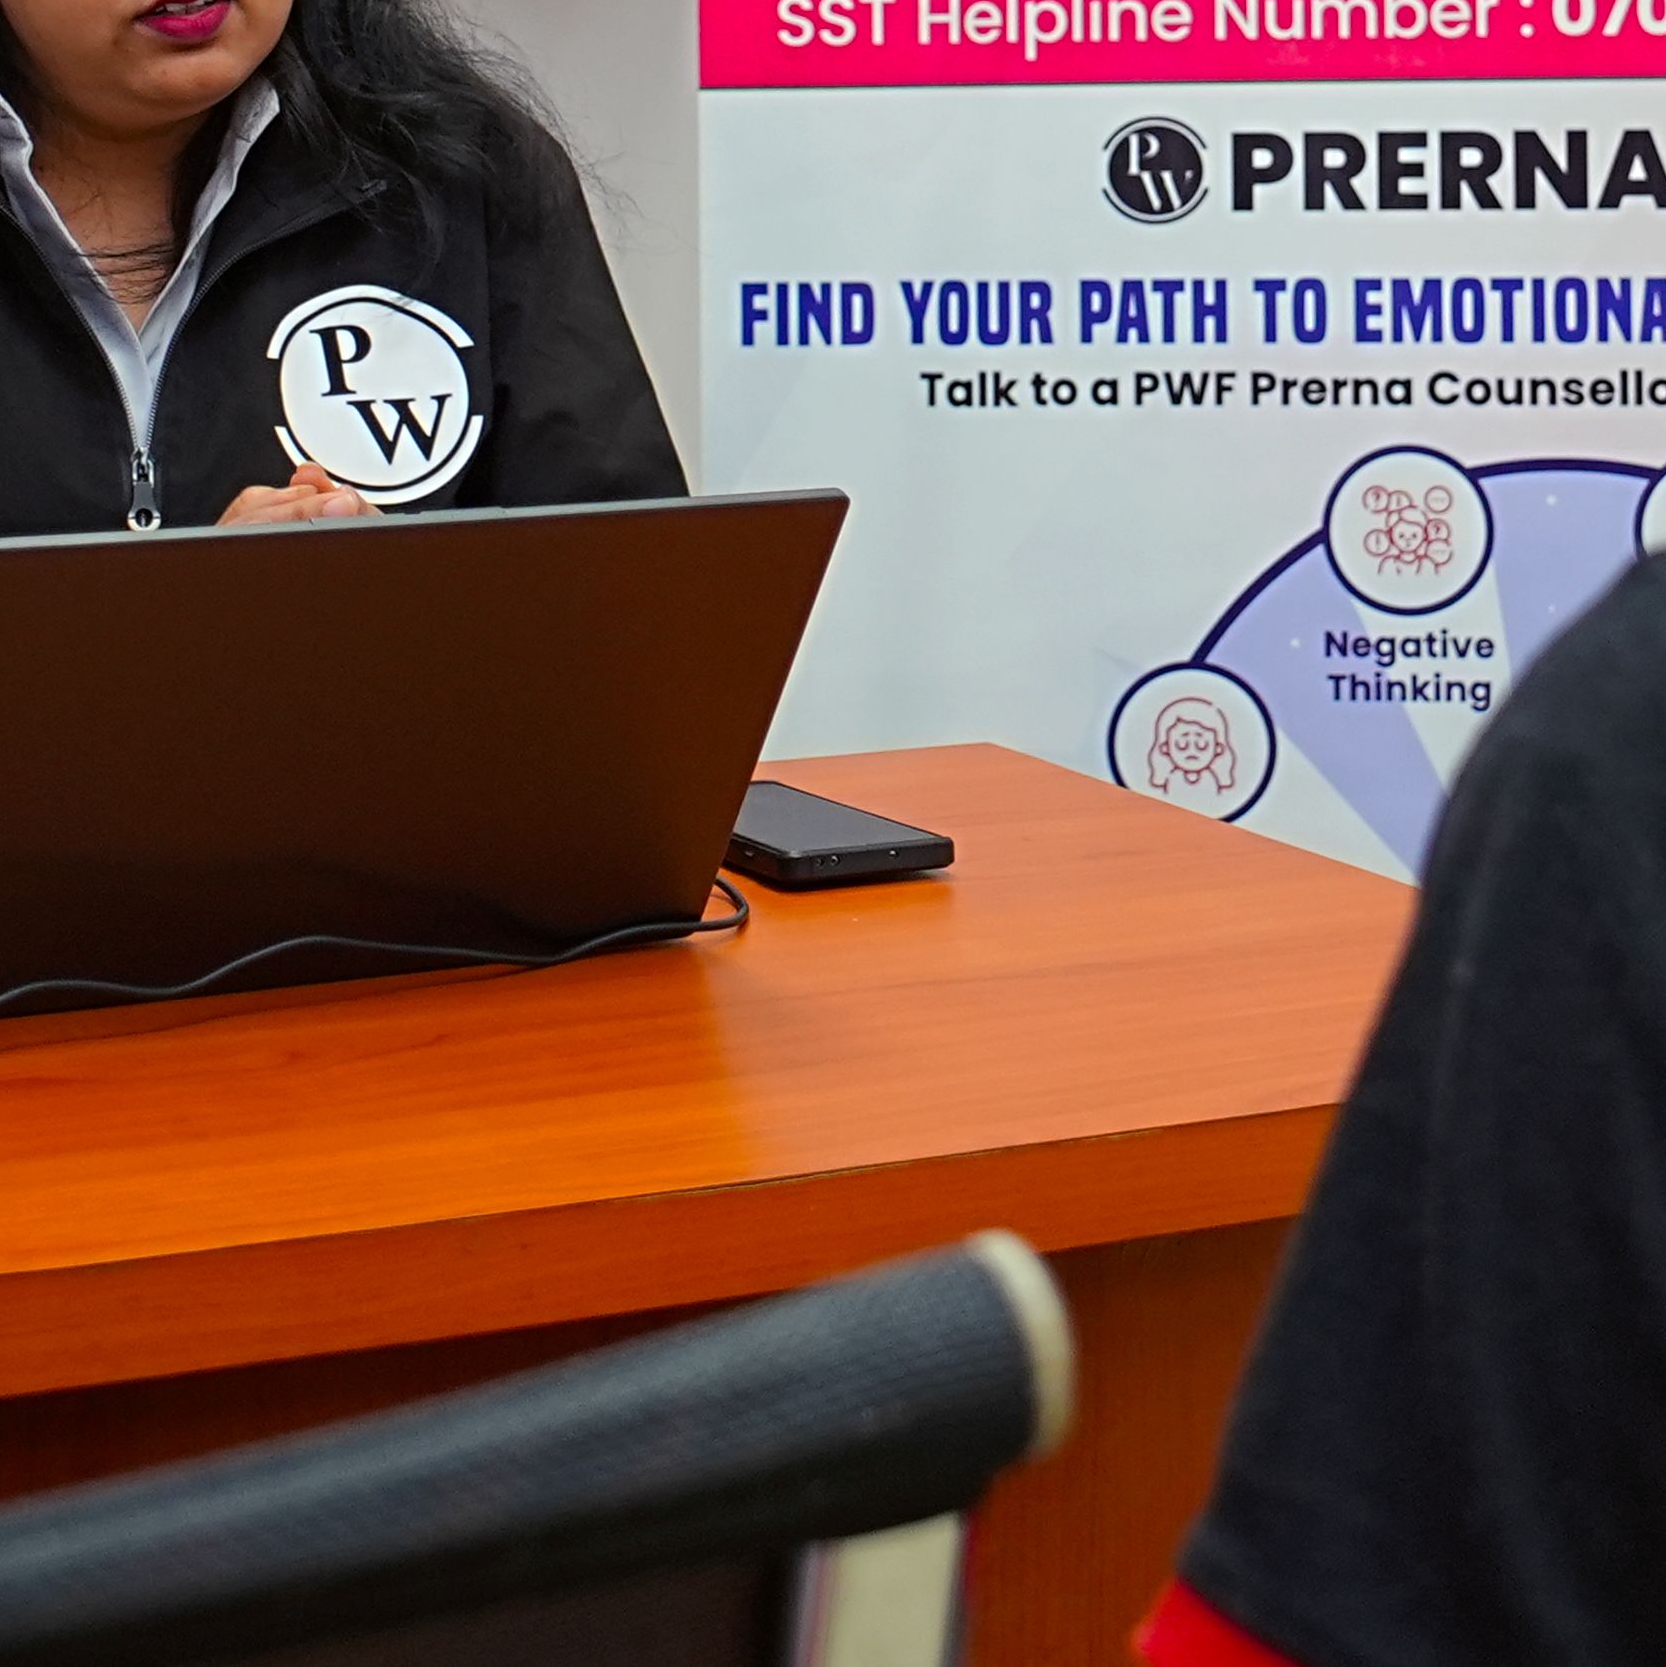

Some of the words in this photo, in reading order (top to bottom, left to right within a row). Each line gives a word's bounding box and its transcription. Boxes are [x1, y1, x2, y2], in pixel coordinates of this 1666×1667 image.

[742, 282, 874, 346] FIND
[900, 280, 1053, 345] YOUR
[1080, 279, 1227, 343] PATH
[1254, 278, 1326, 343] TO
[921, 372, 1017, 407] Talk
[1031, 373, 1077, 405] to
[1092, 379, 1118, 405] a
[1135, 372, 1236, 405] PWF
[1252, 372, 1412, 405] Prerna
[1325, 629, 1494, 667] Negative
[1328, 672, 1494, 712] Thinking
